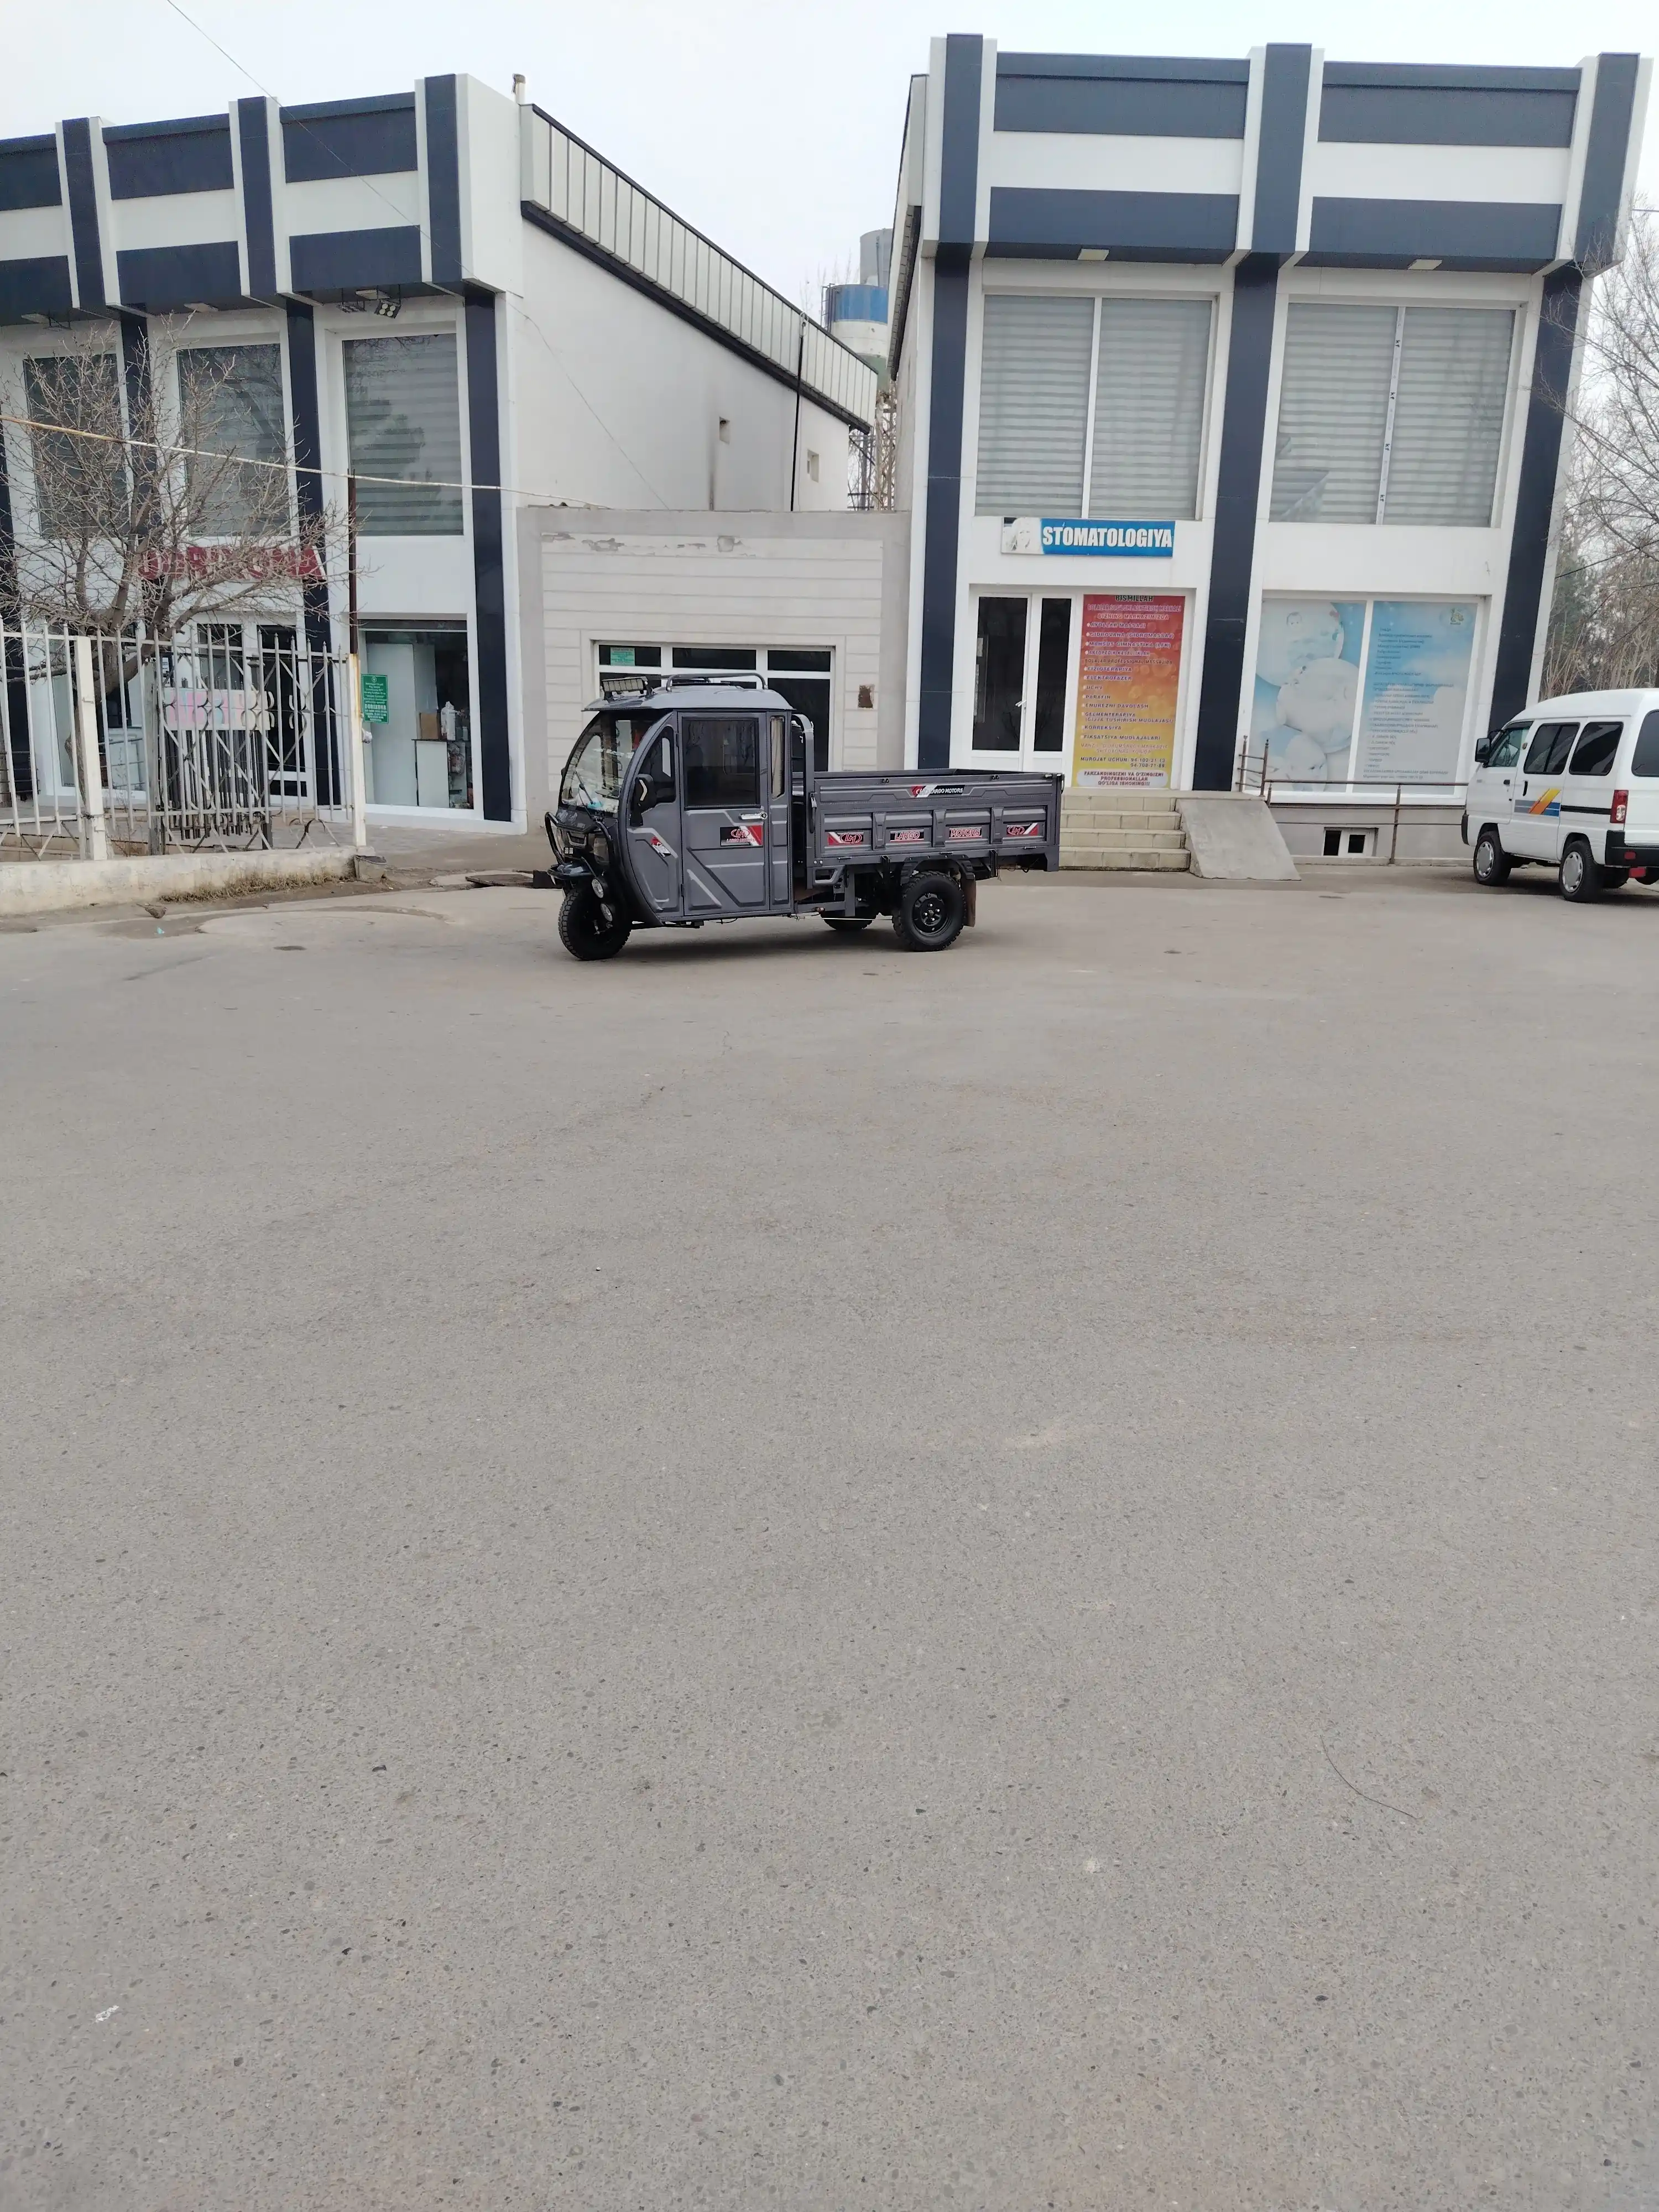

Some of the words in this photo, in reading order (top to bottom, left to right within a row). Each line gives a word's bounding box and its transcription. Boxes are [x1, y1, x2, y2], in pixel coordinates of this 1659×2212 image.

[1042, 526, 1172, 547] STOMATOLOGIYA
[894, 831, 920, 841] LARGO
[951, 827, 981, 837] MOTORS
